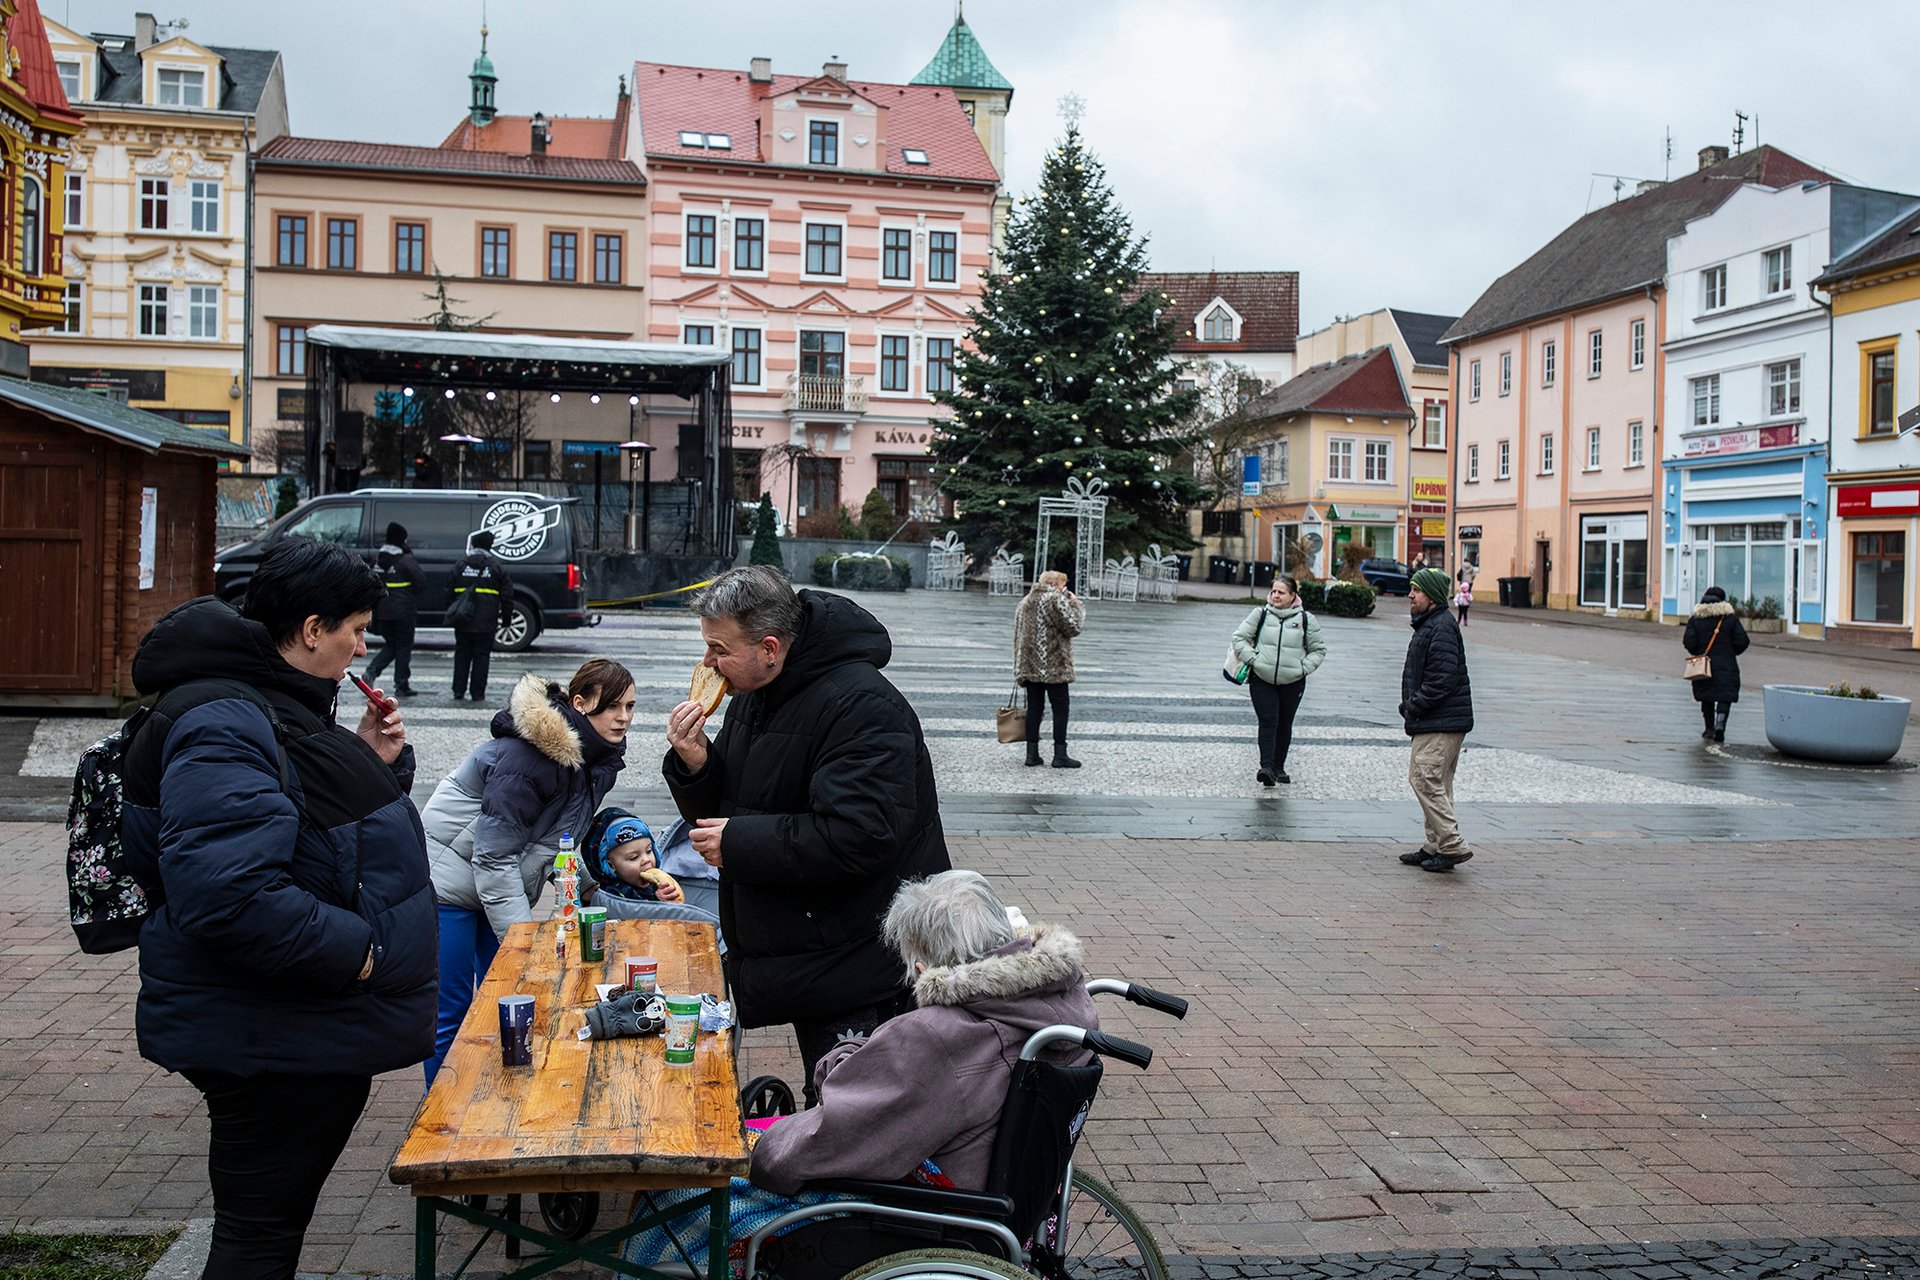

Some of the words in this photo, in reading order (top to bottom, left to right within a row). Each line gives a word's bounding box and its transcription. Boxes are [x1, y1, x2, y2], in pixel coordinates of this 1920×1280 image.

[721, 425, 765, 439] CHY
[875, 427, 915, 444] KÁVA
[486, 503, 532, 526] HUDEBNÍ
[498, 534, 542, 557] SKUPINA
